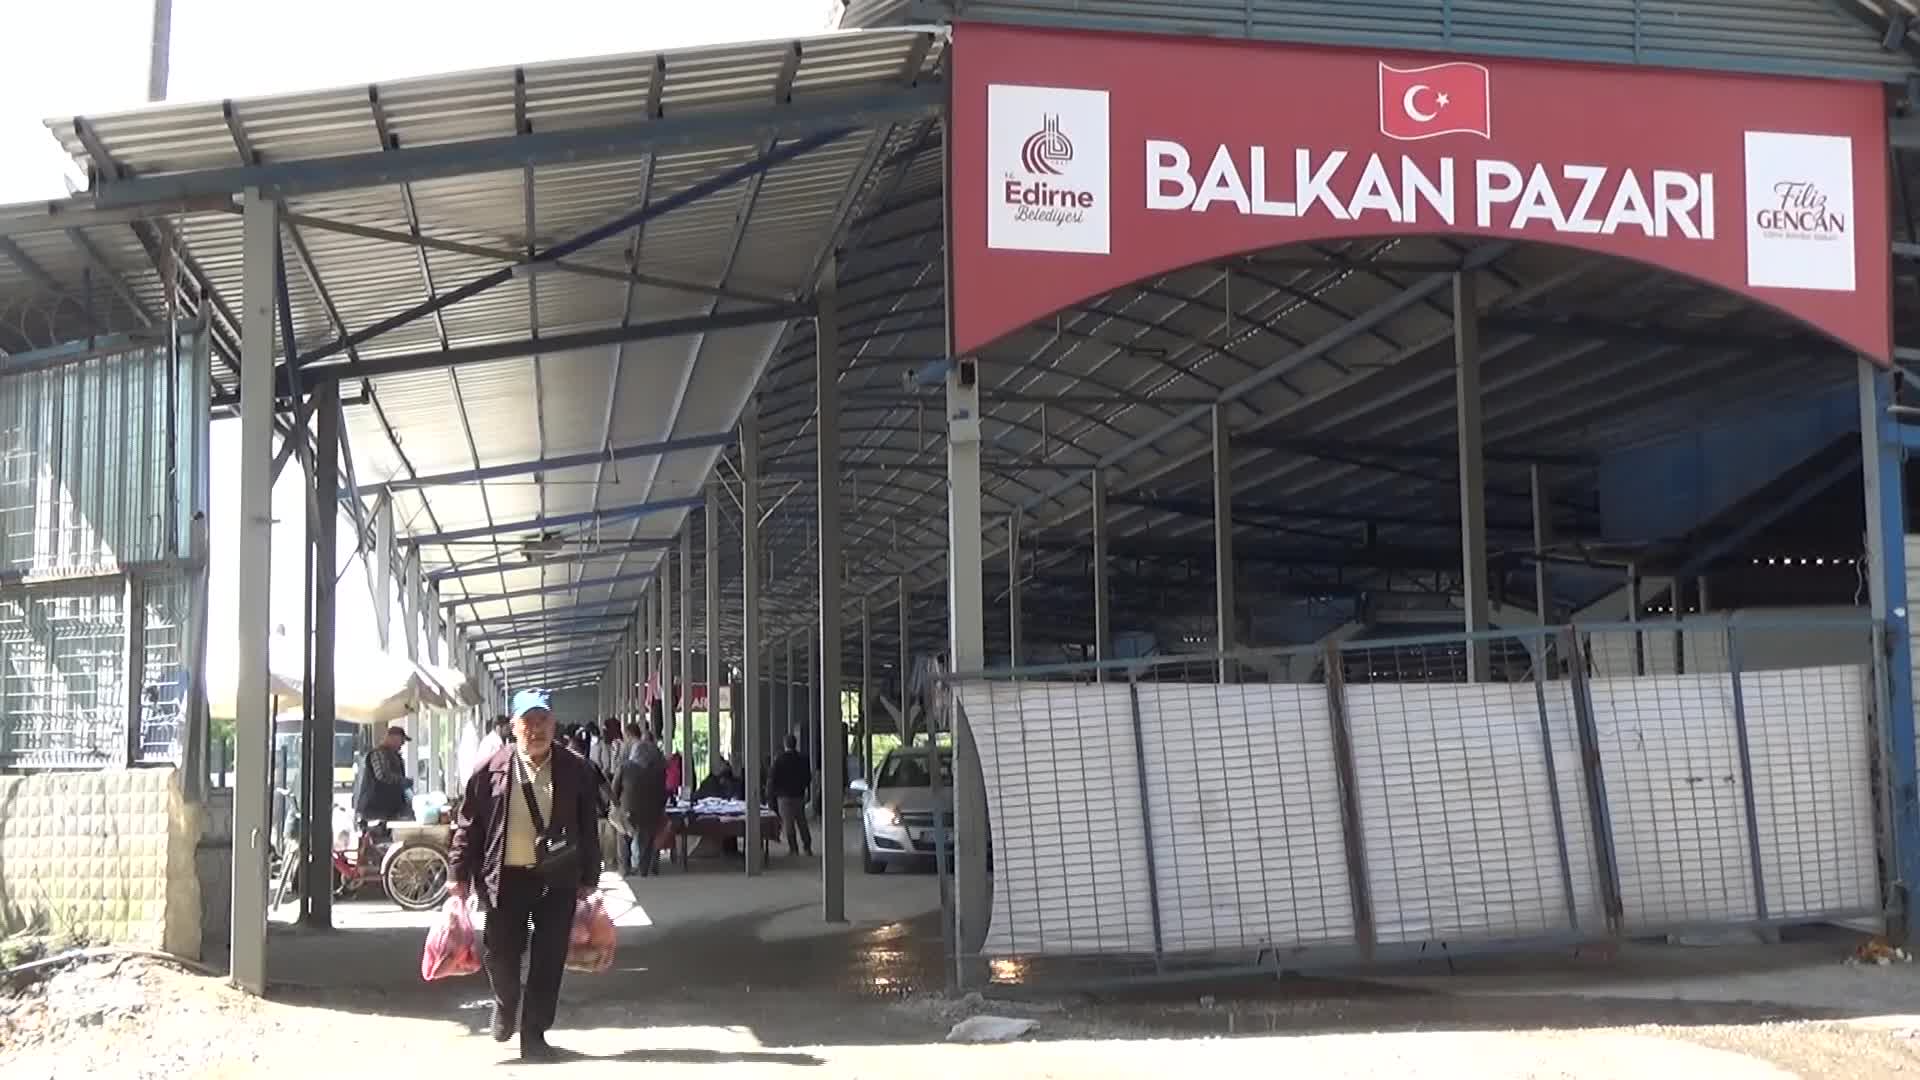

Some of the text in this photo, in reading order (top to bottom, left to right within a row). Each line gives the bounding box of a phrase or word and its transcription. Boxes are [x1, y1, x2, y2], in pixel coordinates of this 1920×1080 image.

[1005, 180, 1094, 208] Edirne
[1146, 139, 1715, 241] BALKAN PAZARI
[1773, 181, 1828, 220] Filiz
[1014, 204, 1084, 228] Belediyesi
[1756, 209, 1845, 233] GENCAN
